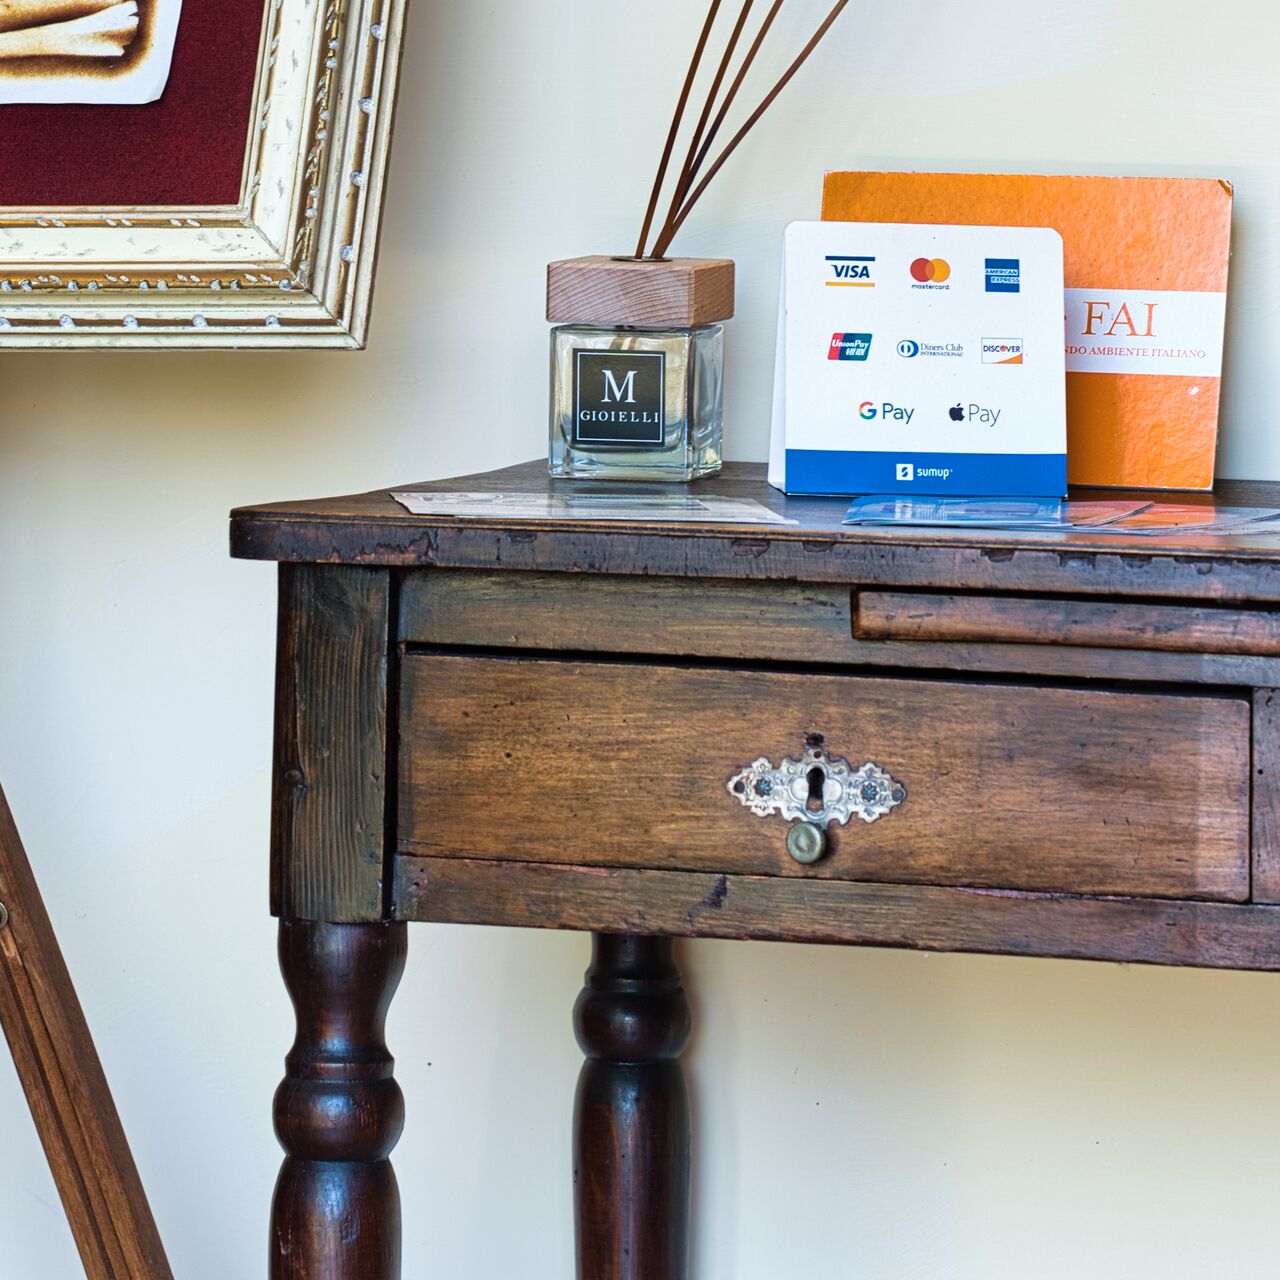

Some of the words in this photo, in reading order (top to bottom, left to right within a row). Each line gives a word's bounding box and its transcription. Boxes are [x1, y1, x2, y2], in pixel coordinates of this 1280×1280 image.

[830, 264, 870, 279] VISA
[911, 283, 950, 291] mastercard
[1081, 301, 1158, 337] FAI
[831, 338, 870, 350] UnionPay
[920, 343, 944, 351] Diners
[945, 343, 964, 352] Club
[983, 345, 1021, 353] DISCOVER
[1090, 346, 1149, 357] AMBIENTE
[1151, 348, 1206, 359] ITALIANO
[600, 369, 638, 403] M
[580, 410, 659, 423] GIOIELLI
[882, 402, 915, 425] Pay
[968, 404, 1001, 427] Pay
[917, 468, 950, 480] sumup
